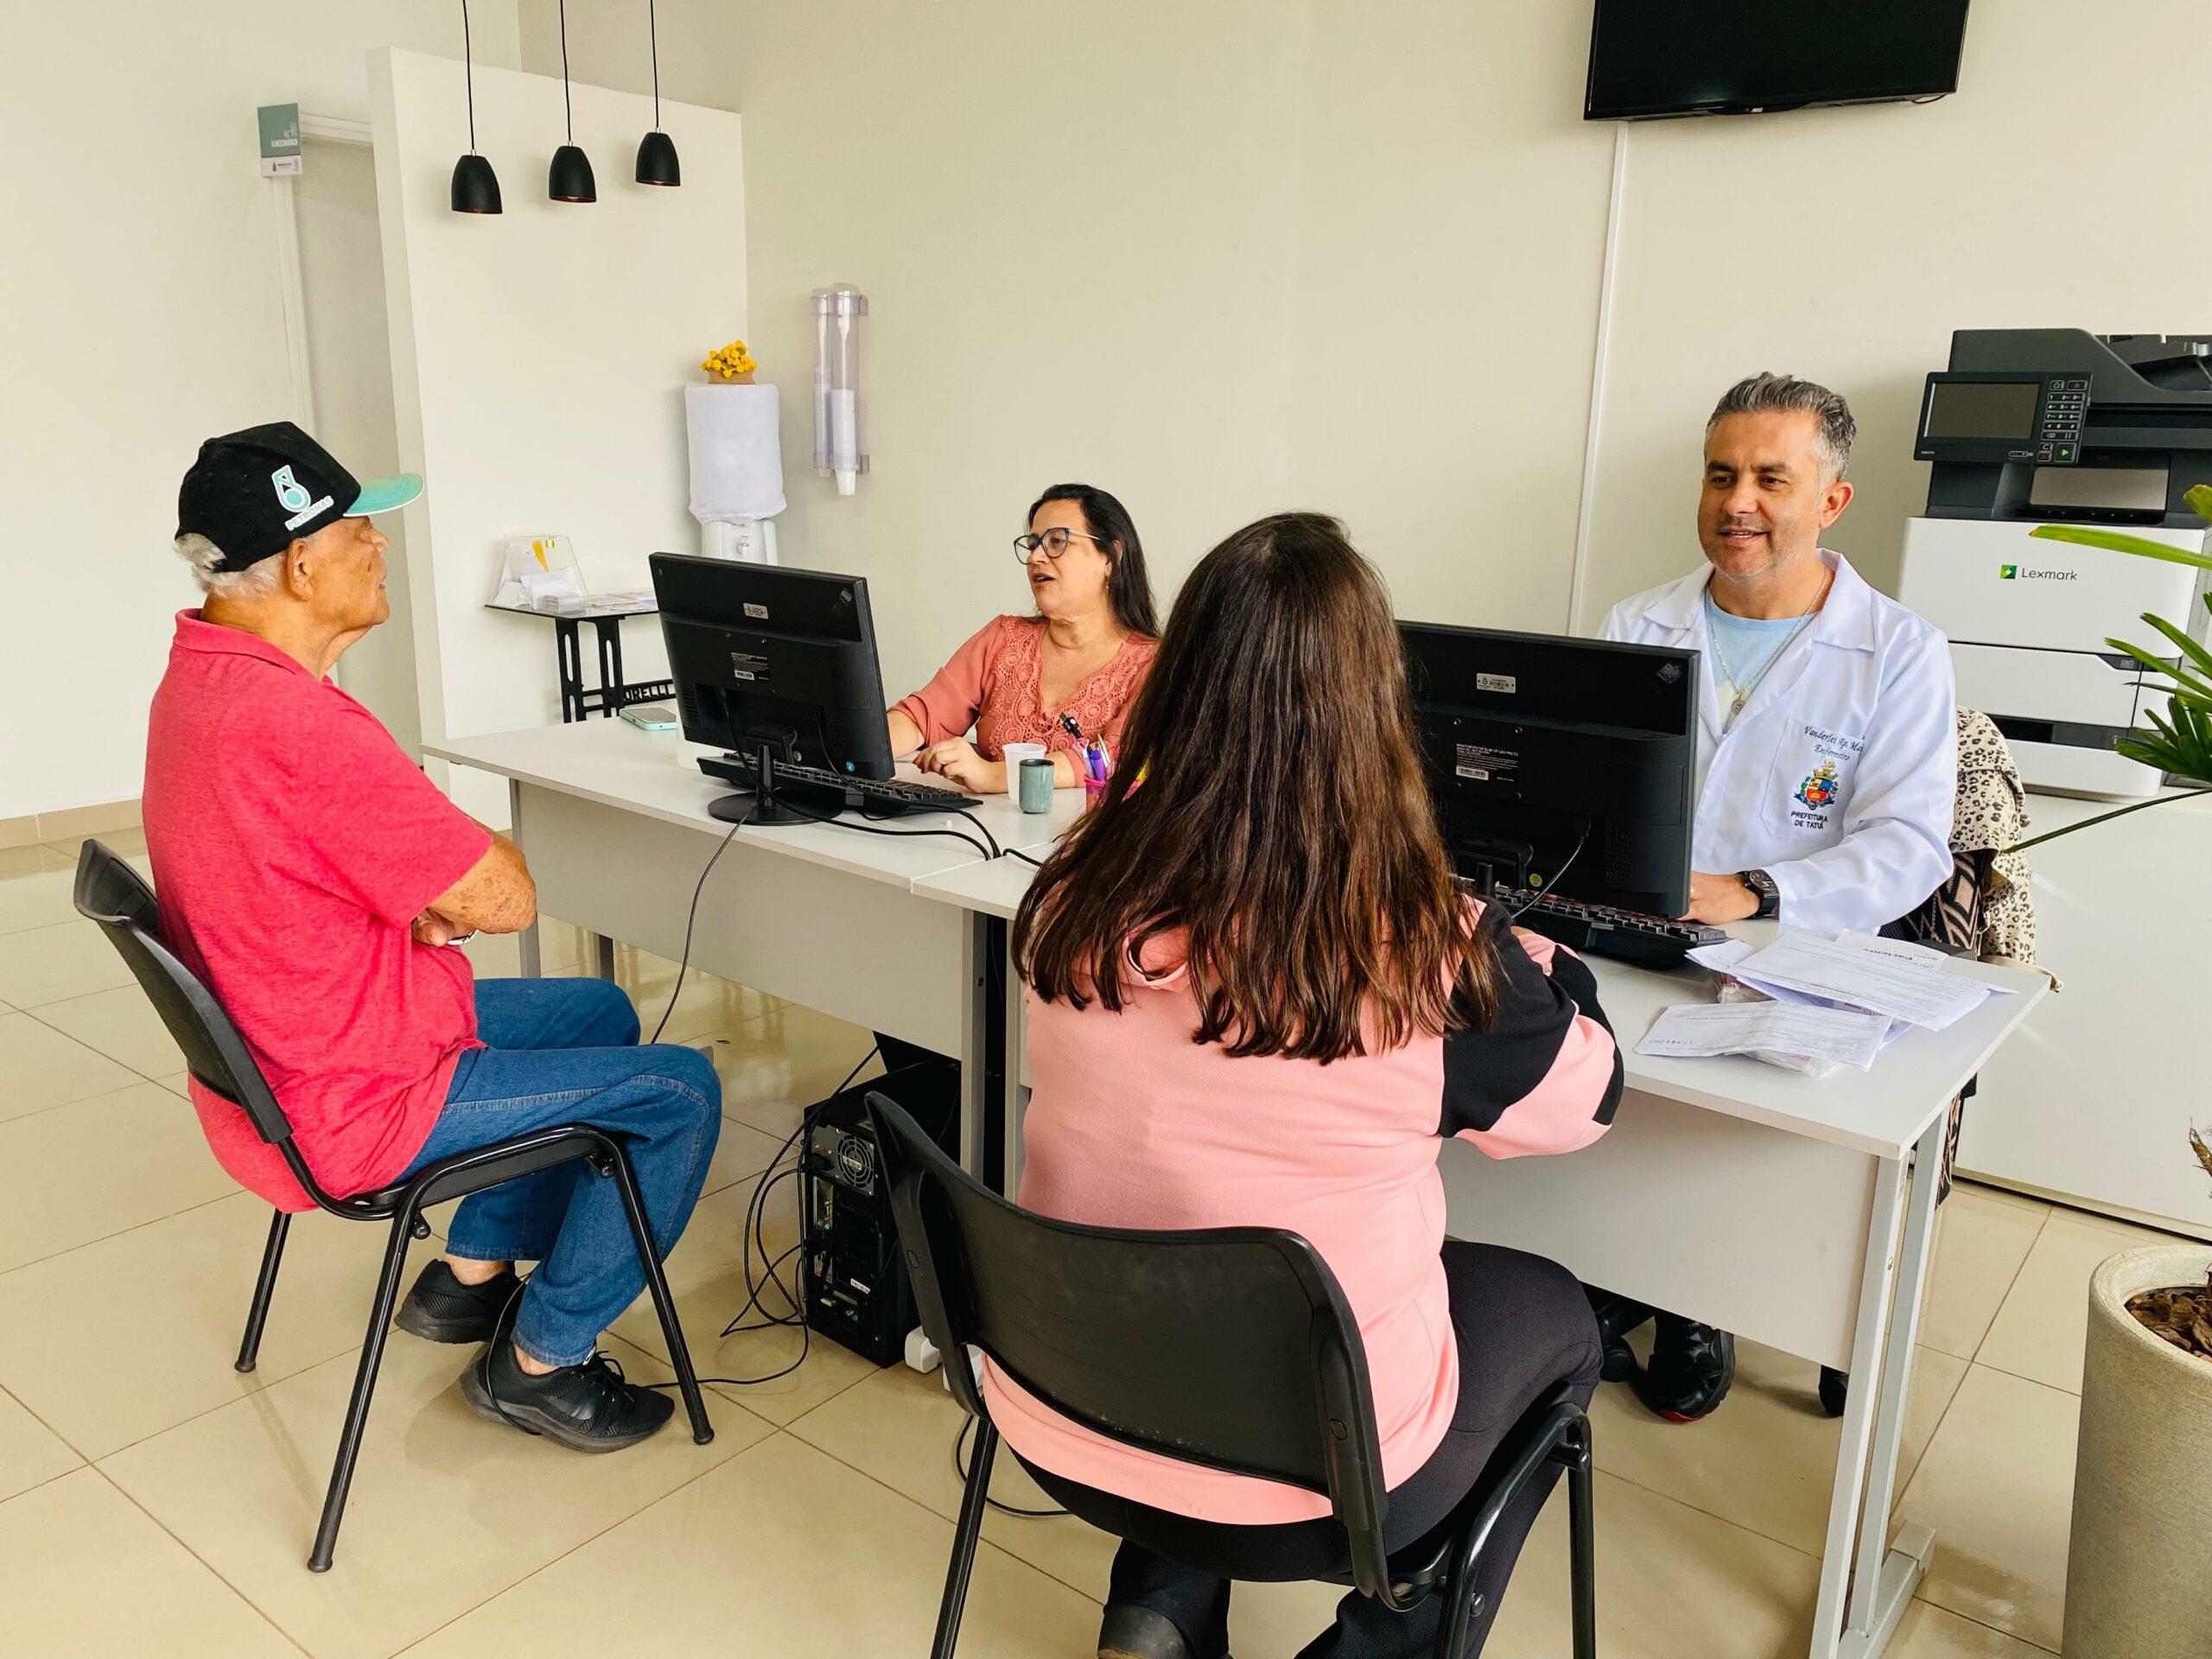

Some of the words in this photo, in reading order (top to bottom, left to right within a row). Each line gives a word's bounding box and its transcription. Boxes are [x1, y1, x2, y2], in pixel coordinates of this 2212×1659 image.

[287, 497, 332, 529] PETRONAS
[2021, 568, 2078, 581] Lexmark
[1815, 744, 1851, 761] Enfermeiro
[1790, 810, 1828, 823] PREFEITURA
